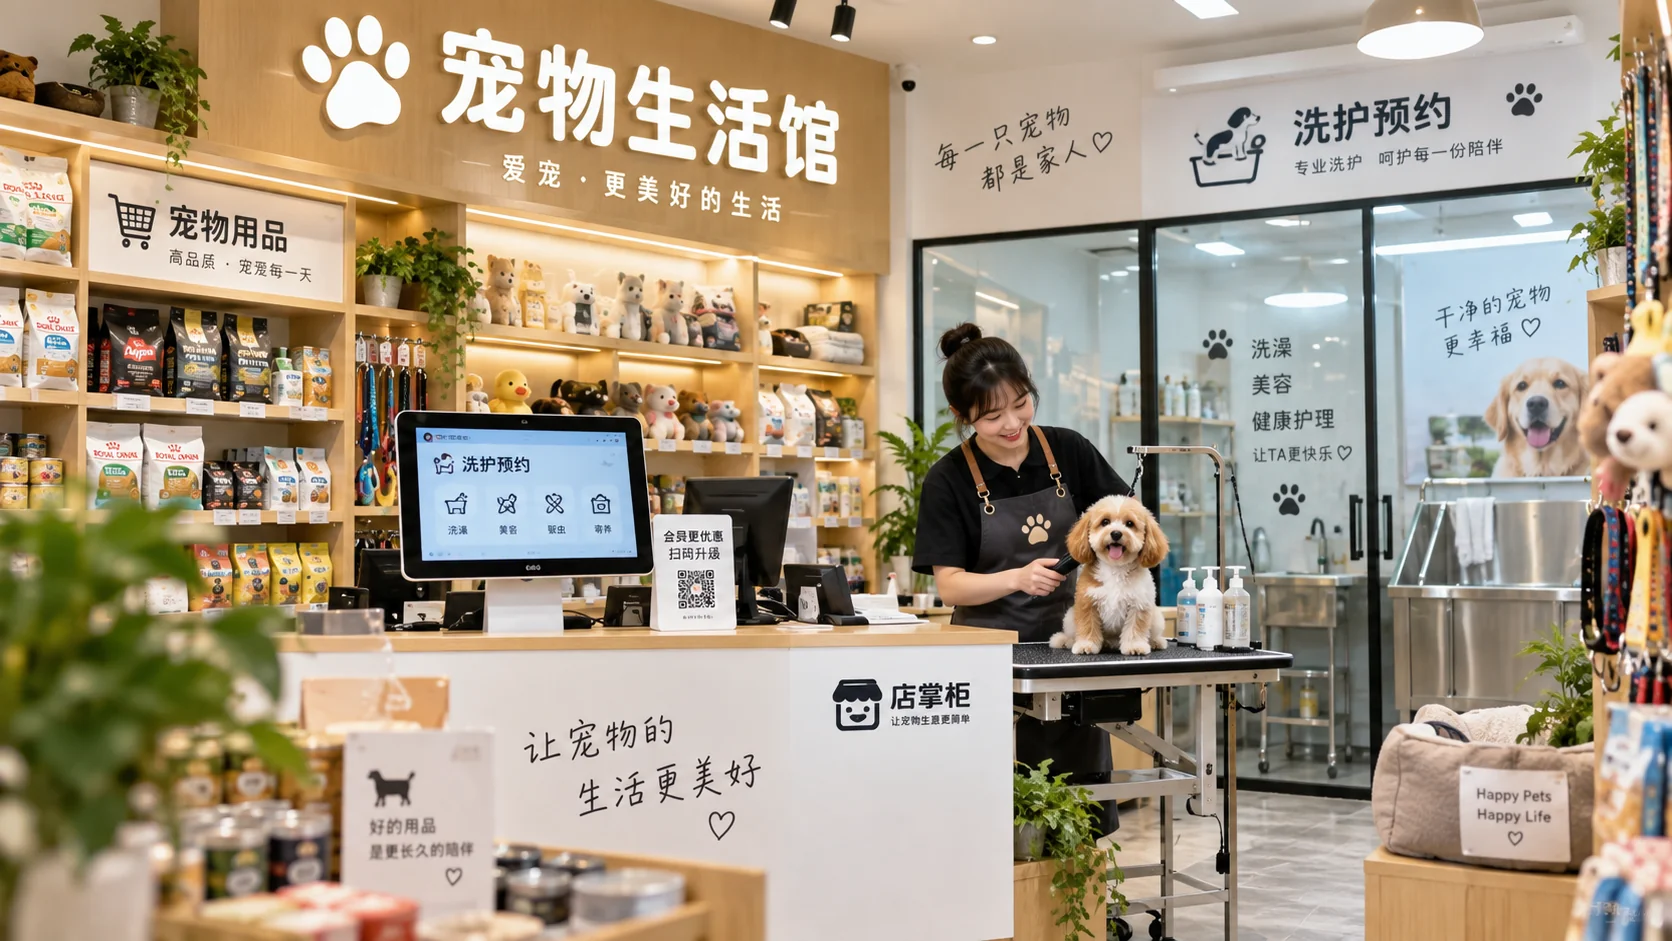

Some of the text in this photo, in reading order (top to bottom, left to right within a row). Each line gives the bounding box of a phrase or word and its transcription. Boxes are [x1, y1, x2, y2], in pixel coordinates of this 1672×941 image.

[441, 28, 839, 185] 宠物生活馆
[1293, 91, 1451, 147] 洗护预约
[935, 105, 1070, 171] 每一只宠物
[981, 140, 1087, 192] 都是家人
[1295, 137, 1503, 175] 专业洗护 呵护每一份陪伴
[170, 205, 287, 258] 宠物用品
[1435, 284, 1551, 328] 干净的宠物
[1252, 337, 1291, 359] 洗澡
[1444, 322, 1512, 359] 更幸福
[1253, 373, 1291, 395] 美容
[1253, 409, 1334, 431] 健康护理
[463, 456, 529, 473] 洗护预约
[1254, 446, 1332, 462] 让TA更快乐
[663, 530, 724, 543] 会员更优惠
[891, 682, 970, 709] 店掌柜
[523, 715, 674, 763] 让宠物的
[579, 754, 761, 817] 生活更美好
[1477, 788, 1551, 803] Happy Pets
[370, 818, 435, 835] 好的用品
[1478, 809, 1551, 824] Happy Life
[371, 842, 472, 859] 是更长久的陪伴
